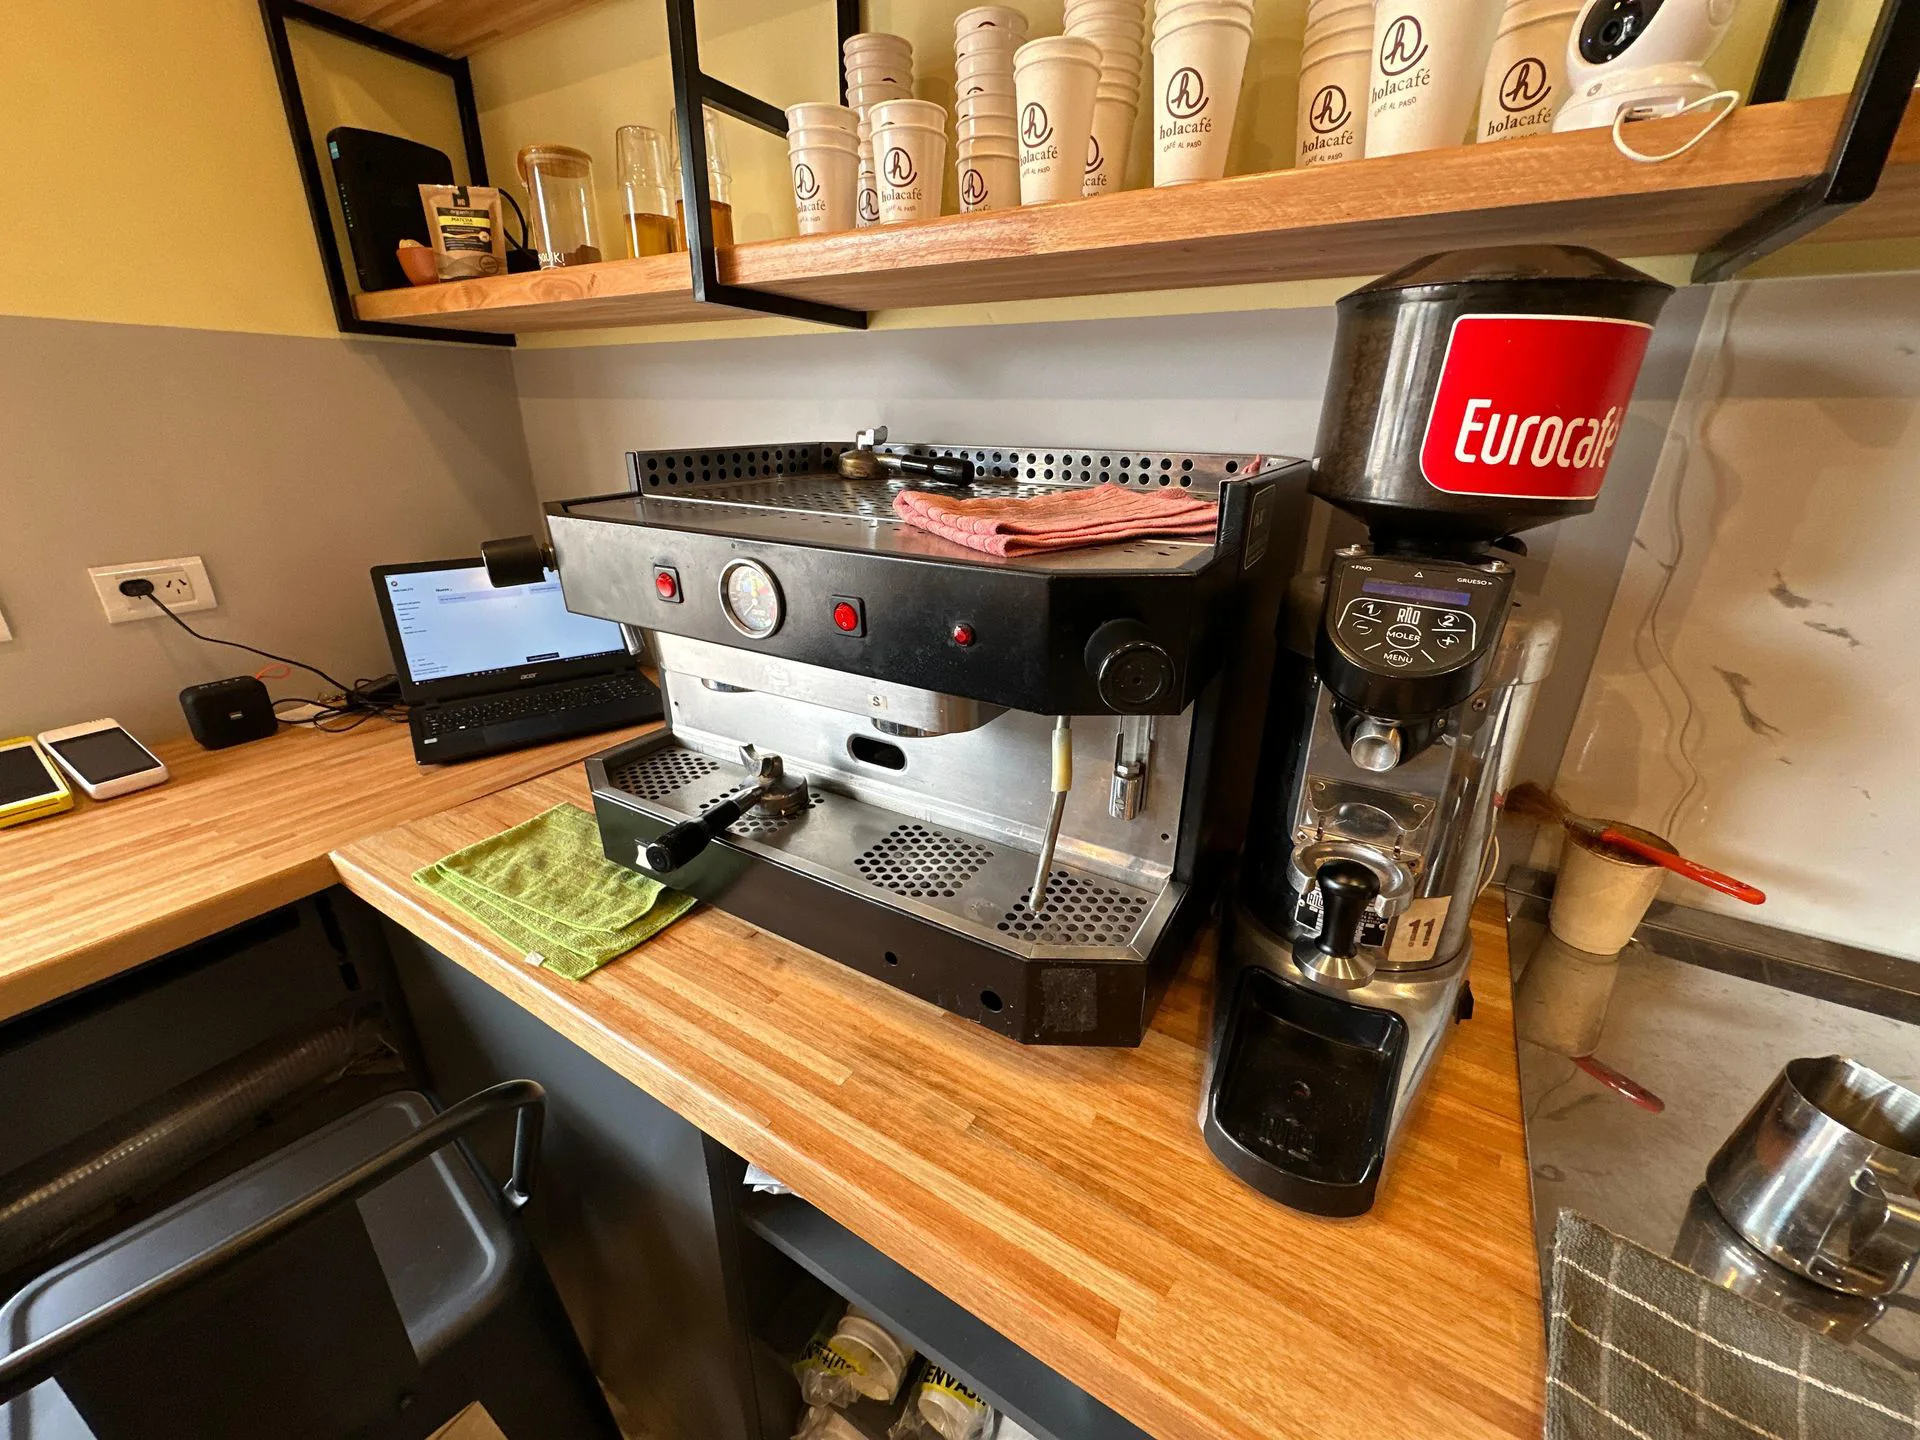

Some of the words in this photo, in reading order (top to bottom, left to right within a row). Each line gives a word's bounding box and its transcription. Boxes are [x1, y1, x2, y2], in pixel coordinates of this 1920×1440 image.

[1371, 68, 1431, 104] holacafé
[1398, 96, 1417, 109] PASO
[1487, 107, 1552, 136] holacafé
[1159, 117, 1212, 141] holacafé
[1186, 140, 1202, 149] PASO
[1302, 131, 1354, 155] holacafé
[1327, 152, 1343, 161] PASO
[881, 188, 922, 203] holacafé
[1355, 564, 1372, 572] FINO
[1457, 577, 1488, 586] GRUESO
[1386, 631, 1421, 642] MOLER
[1384, 653, 1414, 664] MENU
[872, 695, 881, 707] S
[1408, 918, 1436, 948] 11
